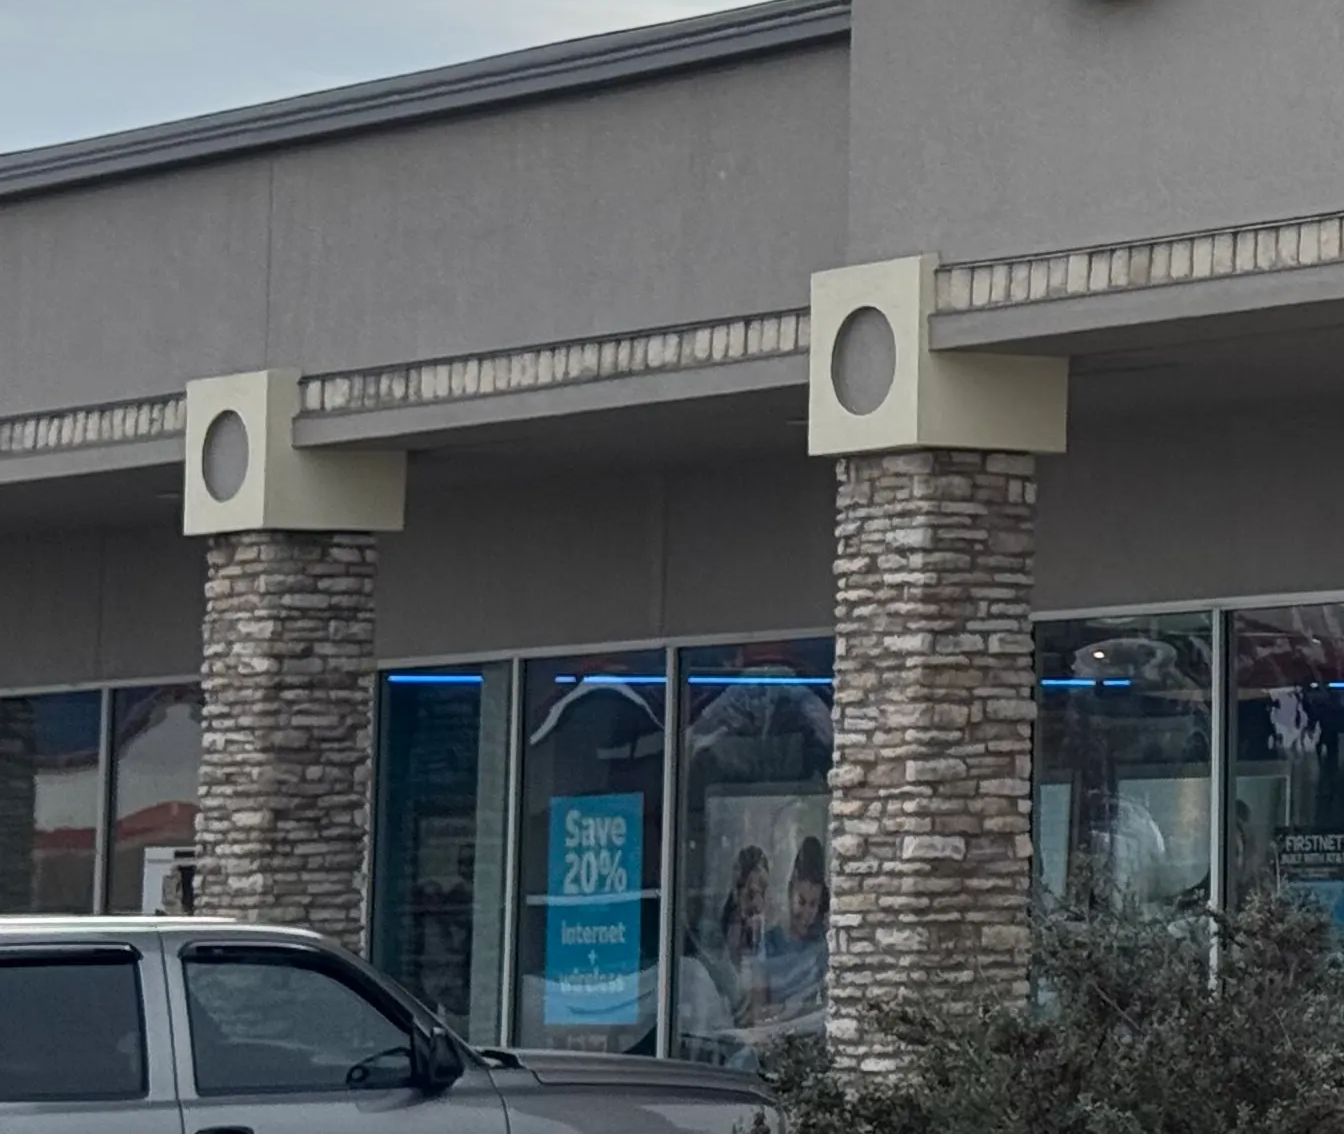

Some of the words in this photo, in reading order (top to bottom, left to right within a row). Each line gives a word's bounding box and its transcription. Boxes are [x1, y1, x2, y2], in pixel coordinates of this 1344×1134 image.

[565, 809, 626, 847] Save
[1286, 834, 1344, 852] FIRSTNET
[563, 849, 627, 895] 20%
[562, 920, 626, 945] Internet
